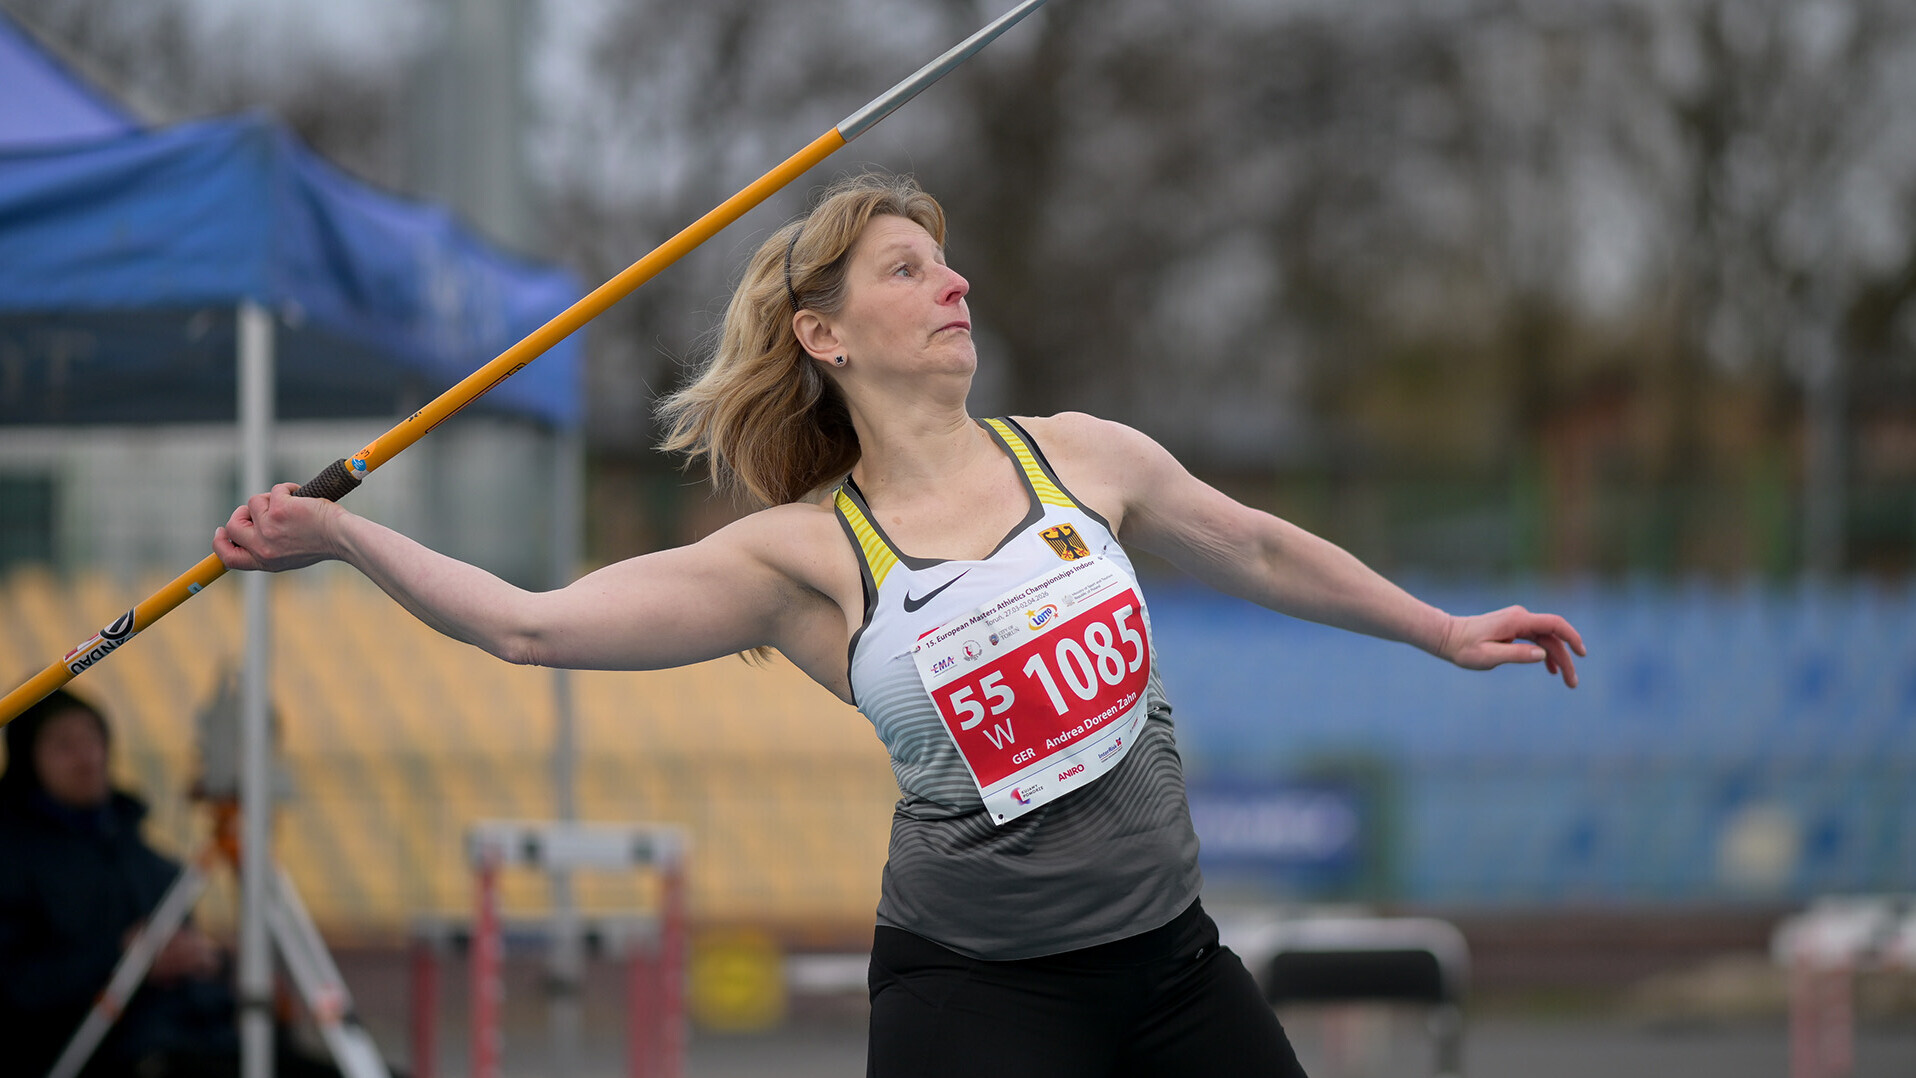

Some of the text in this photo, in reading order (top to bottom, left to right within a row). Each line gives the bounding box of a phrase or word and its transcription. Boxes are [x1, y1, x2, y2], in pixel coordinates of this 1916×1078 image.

[926, 560, 1095, 649] 15. European Masters Athletics Championships Indoor
[1032, 607, 1052, 626] LOTTO
[931, 656, 954, 674] EMA
[1022, 604, 1144, 716] 1085
[949, 670, 1015, 731] 55
[983, 718, 1015, 750] W
[1045, 725, 1085, 749] Andrea
[1083, 705, 1118, 729] Doreen
[1117, 691, 1137, 710] Zahn
[1012, 747, 1036, 765] GER
[1058, 763, 1085, 782] ANIRO
